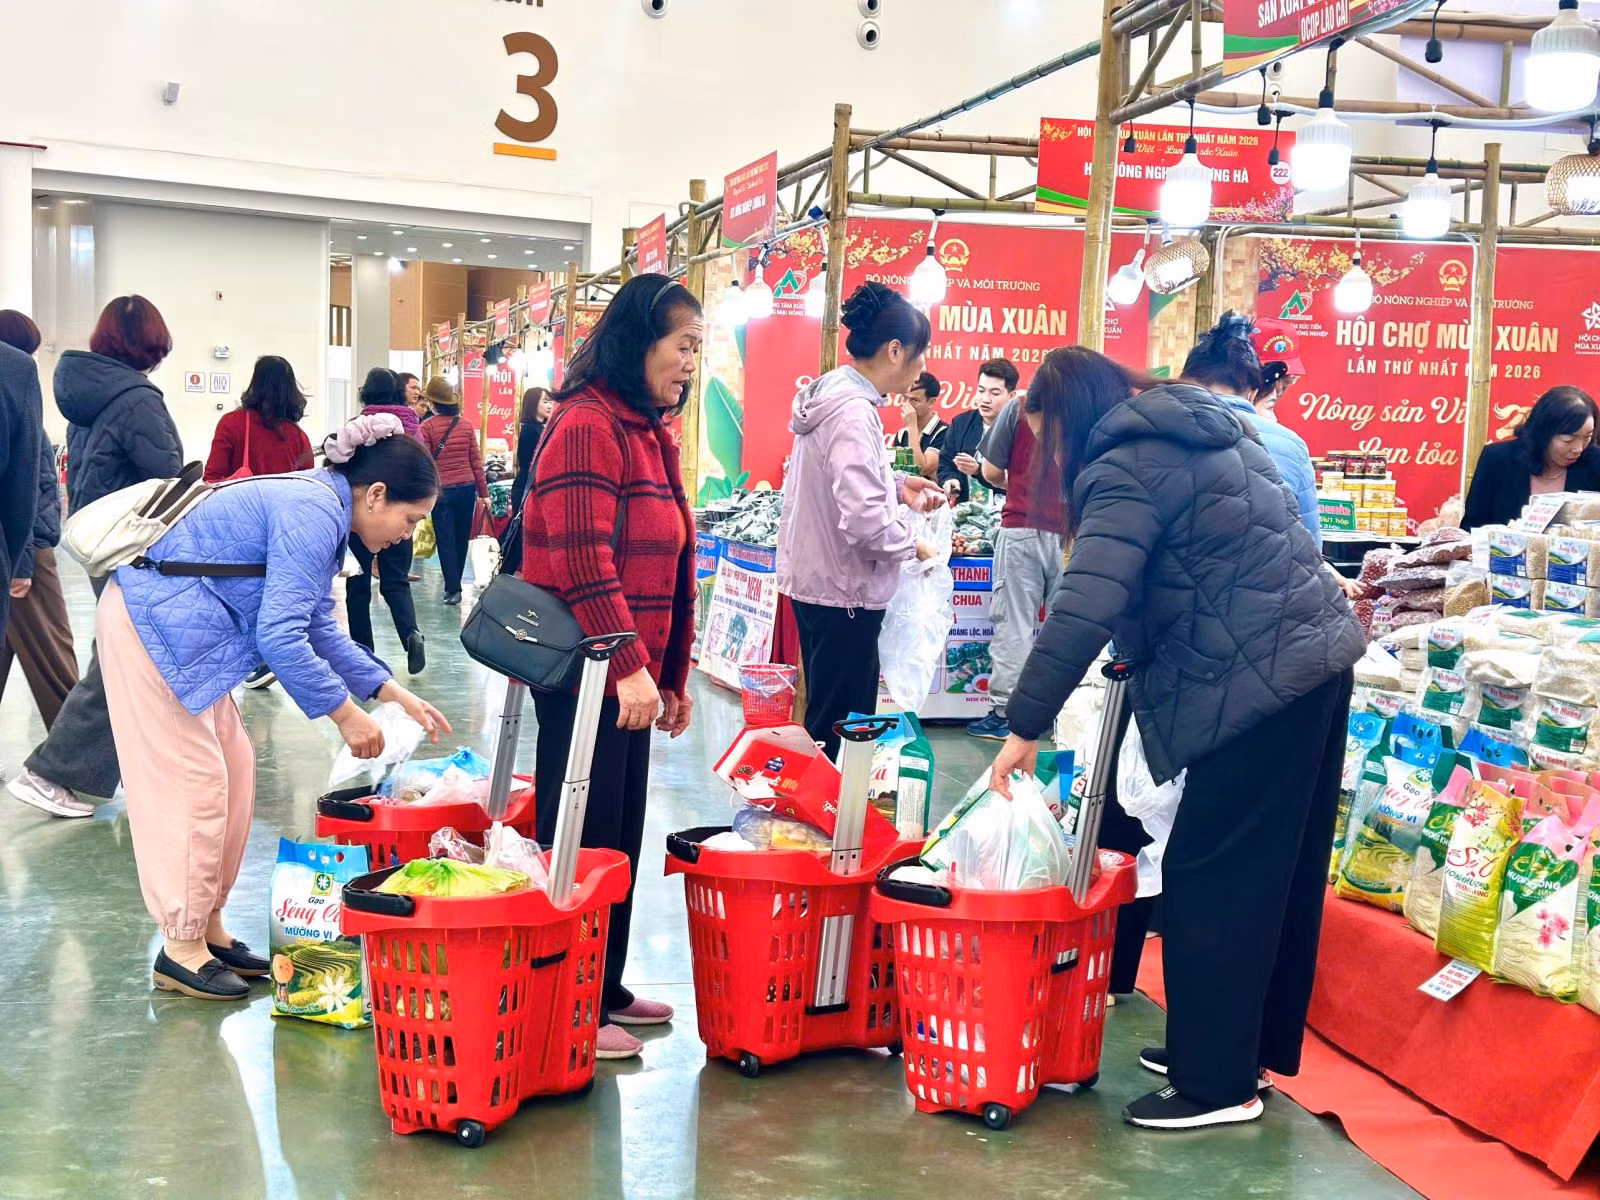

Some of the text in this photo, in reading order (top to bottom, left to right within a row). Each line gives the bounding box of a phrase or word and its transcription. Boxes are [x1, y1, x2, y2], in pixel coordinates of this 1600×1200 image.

[1301, 11, 1320, 42] OCOP
[495, 32, 558, 142] 3
[1133, 129, 1156, 141] XUÂN
[1217, 133, 1237, 145] NĂM
[1118, 161, 1142, 178] ÔNG
[1233, 167, 1249, 183] HÀ
[1273, 167, 1289, 178] 222
[958, 277, 972, 289] VÀ
[974, 278, 993, 289] MÔI
[1383, 294, 1414, 305] NÔNG
[1416, 296, 1452, 308] NGHIỆP
[1454, 297, 1468, 308] VÀ
[939, 300, 1067, 336] MÙA XUÂN
[1336, 314, 1559, 354] HỘI CHỢ MÙ XUÂN
[970, 344, 1004, 361] NĂM
[1348, 355, 1377, 374] LẦN
[1384, 358, 1414, 375] THỨ
[1419, 357, 1458, 377] NHẤT
[1504, 364, 1541, 379] 2026
[1299, 392, 1376, 431] Nông
[1379, 399, 1427, 423] sản
[1414, 440, 1459, 466] tỏa
[952, 567, 990, 582] THANH
[952, 594, 982, 606] CHUA
[1406, 815, 1417, 824] VI
[308, 896, 325, 905] Gạo
[285, 926, 333, 939] MƯỜNG VI
